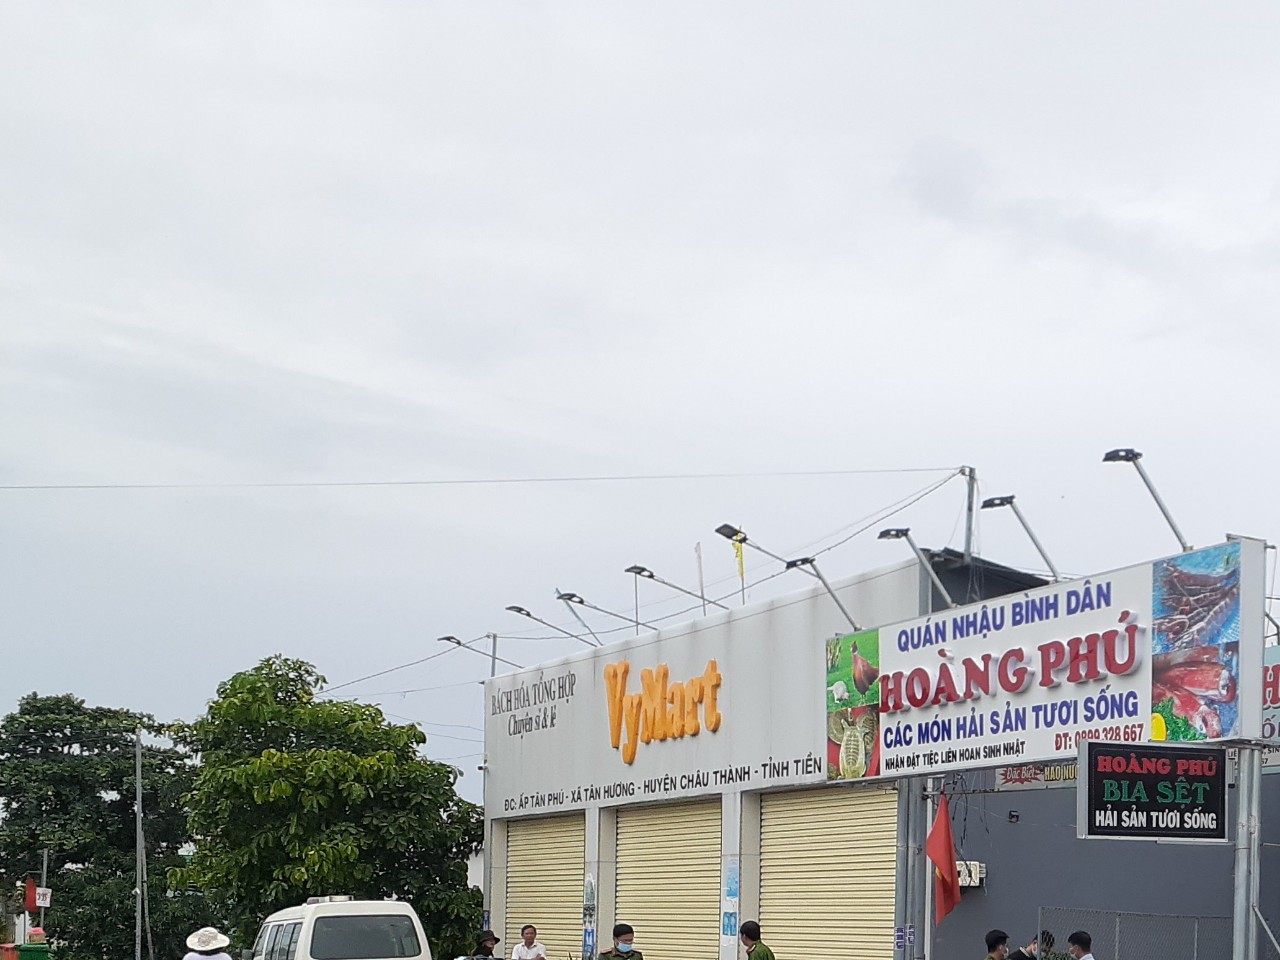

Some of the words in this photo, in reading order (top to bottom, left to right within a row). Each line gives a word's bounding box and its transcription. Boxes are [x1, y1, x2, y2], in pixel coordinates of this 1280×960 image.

[898, 617, 947, 652] QUÁN
[952, 605, 1005, 640] NHẬU
[1012, 592, 1059, 627] BÌNH
[1066, 580, 1111, 615] DÂN
[878, 647, 1032, 713] HOÀNG
[1038, 610, 1142, 688] PHÚ
[491, 688, 513, 716] BÁCH
[513, 680, 531, 711] HÓA
[532, 671, 557, 705] TỔNG
[557, 670, 577, 704] HỢP
[604, 659, 722, 766] VyMart
[508, 712, 533, 739] Chuyên
[541, 707, 549, 729] &
[883, 717, 913, 749] CÁC
[917, 714, 951, 743] MÓN
[956, 707, 984, 738] HẢI
[989, 701, 1027, 734] SẢN
[1032, 699, 1078, 729] TƯƠI
[1083, 684, 1139, 722] SỐNG
[1123, 723, 1144, 742] 667
[885, 754, 905, 772] NHẬN
[906, 752, 920, 771] ĐẶT
[922, 750, 939, 768] TIỆC
[940, 747, 957, 764] LIÊN
[960, 746, 981, 762] HOAN
[983, 744, 1001, 759] SINH
[1003, 738, 1026, 757] NHẬT
[1096, 753, 1172, 775] HOÀNG
[1176, 756, 1217, 777] PHÚ
[518, 792, 529, 809] ẤP
[531, 791, 546, 808] TÂN
[547, 789, 564, 806] PHÚ
[570, 786, 582, 803] XÃ
[584, 784, 601, 801] TÂN
[603, 781, 635, 799] HƯƠNG
[643, 773, 677, 794] HUYỆN
[680, 768, 710, 789] CHÂU
[712, 764, 751, 785] THÀNH
[761, 756, 790, 779] TỈNH
[793, 752, 822, 775] TIỀN
[1102, 779, 1149, 803] BIA
[1156, 777, 1210, 809] SỆT
[1095, 804, 1118, 827] HẢI
[1121, 804, 1147, 828] SẢN
[1150, 809, 1181, 828] TƯƠI
[1183, 807, 1217, 829] SỐNG
